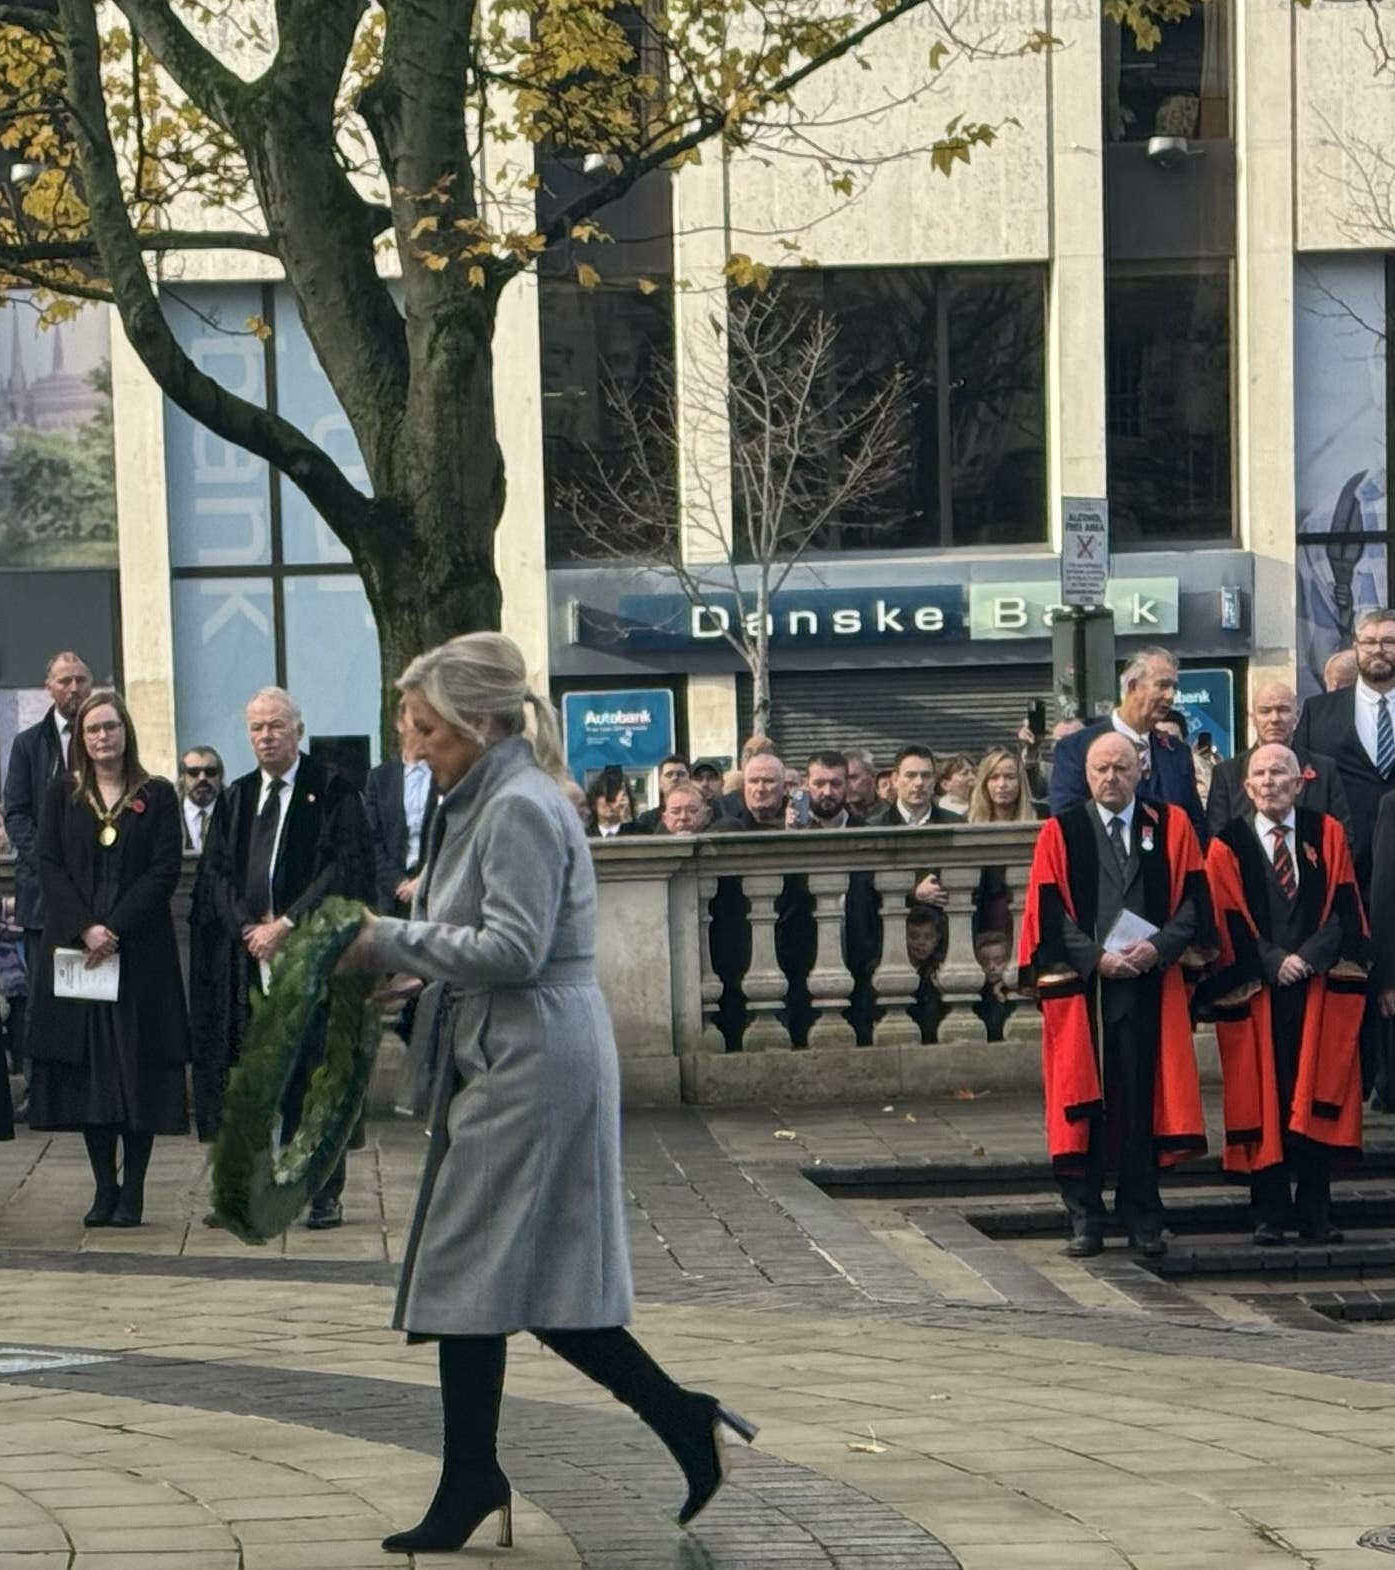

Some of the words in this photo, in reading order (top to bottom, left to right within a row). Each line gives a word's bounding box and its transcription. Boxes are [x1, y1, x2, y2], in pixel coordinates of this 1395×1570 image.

[691, 600, 944, 639] Danske
[994, 591, 1159, 628] Bak
[584, 709, 652, 726] Autobank
